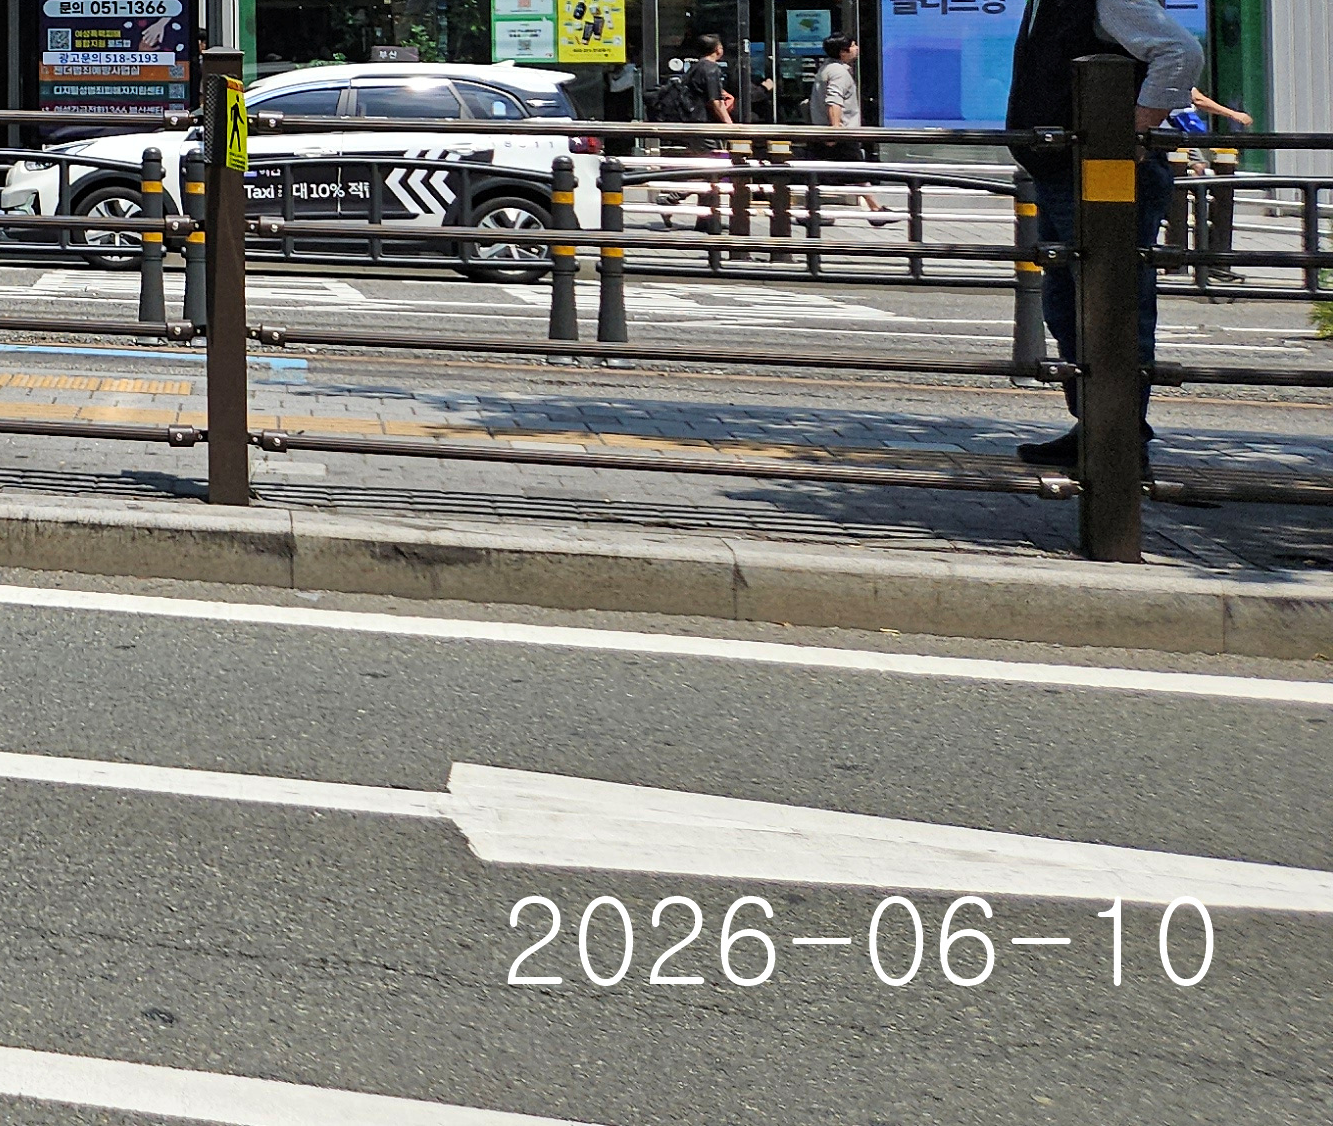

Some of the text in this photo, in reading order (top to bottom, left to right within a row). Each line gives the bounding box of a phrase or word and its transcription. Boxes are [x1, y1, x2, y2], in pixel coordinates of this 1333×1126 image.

[59, 0, 167, 15] 문의 051-1366
[58, 52, 159, 64] 광고문의 518-5193
[243, 184, 275, 199] Taxi
